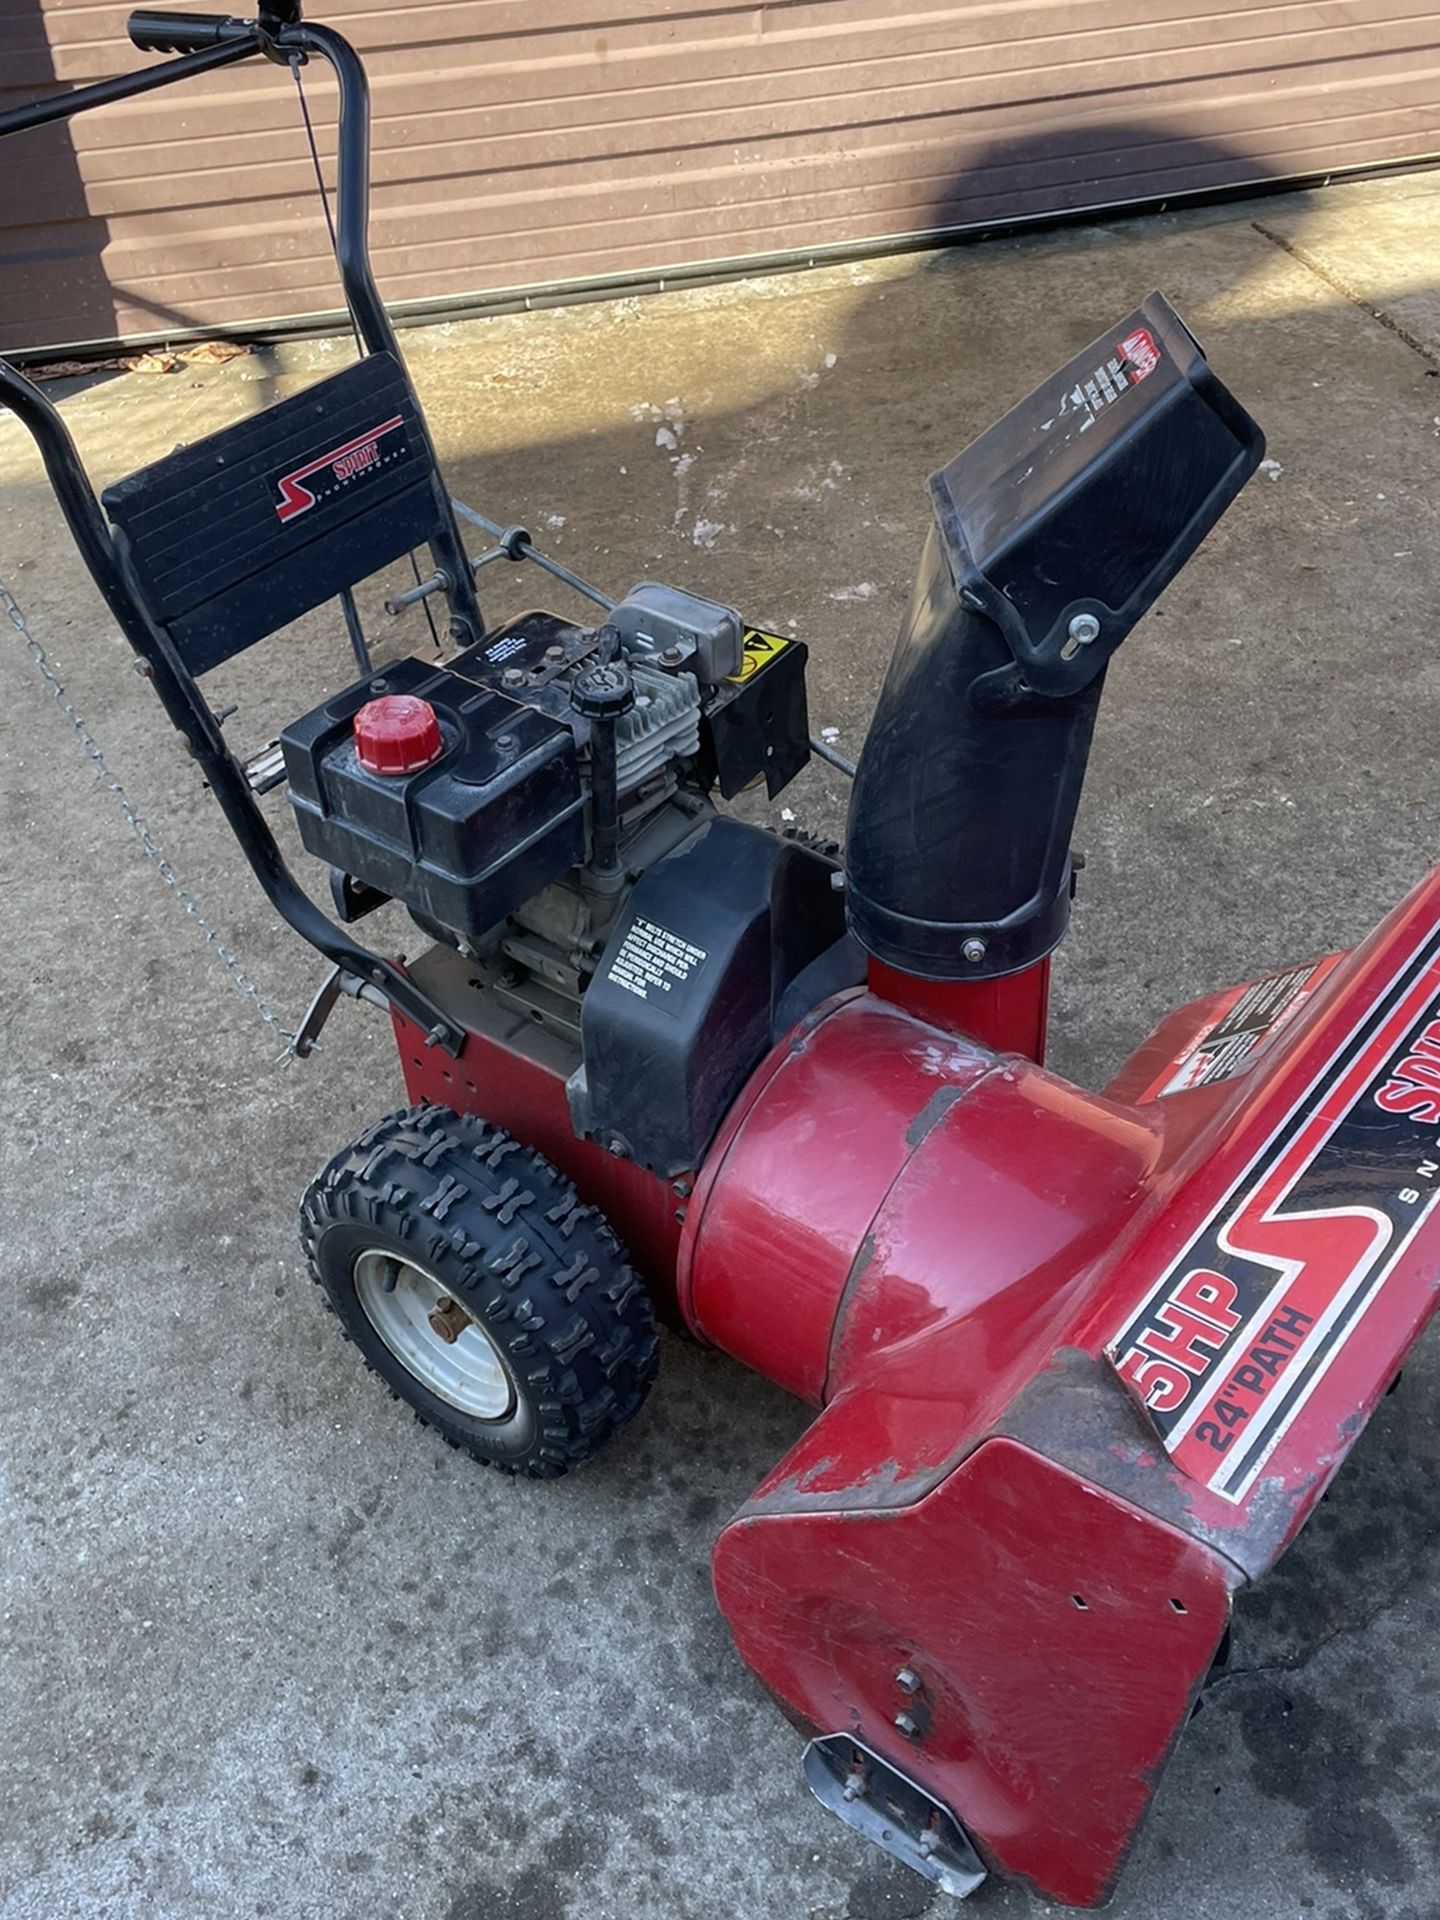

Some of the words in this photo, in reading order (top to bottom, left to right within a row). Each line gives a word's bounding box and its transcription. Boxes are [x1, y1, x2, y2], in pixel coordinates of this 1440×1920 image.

[332, 441, 379, 480] SPIRIT
[626, 932, 648, 947] AFFECT
[645, 942, 677, 964] DISCHARGE
[661, 931, 687, 949] STRETCH
[626, 952, 664, 976] PERIODICALLY
[665, 943, 685, 958] WHICH
[683, 952, 698, 966] WILL
[651, 956, 666, 968] AND
[664, 962, 688, 980] SHOULD
[633, 975, 647, 988] FOR
[662, 980, 672, 992] TO
[1115, 1268, 1243, 1412] 5HP
